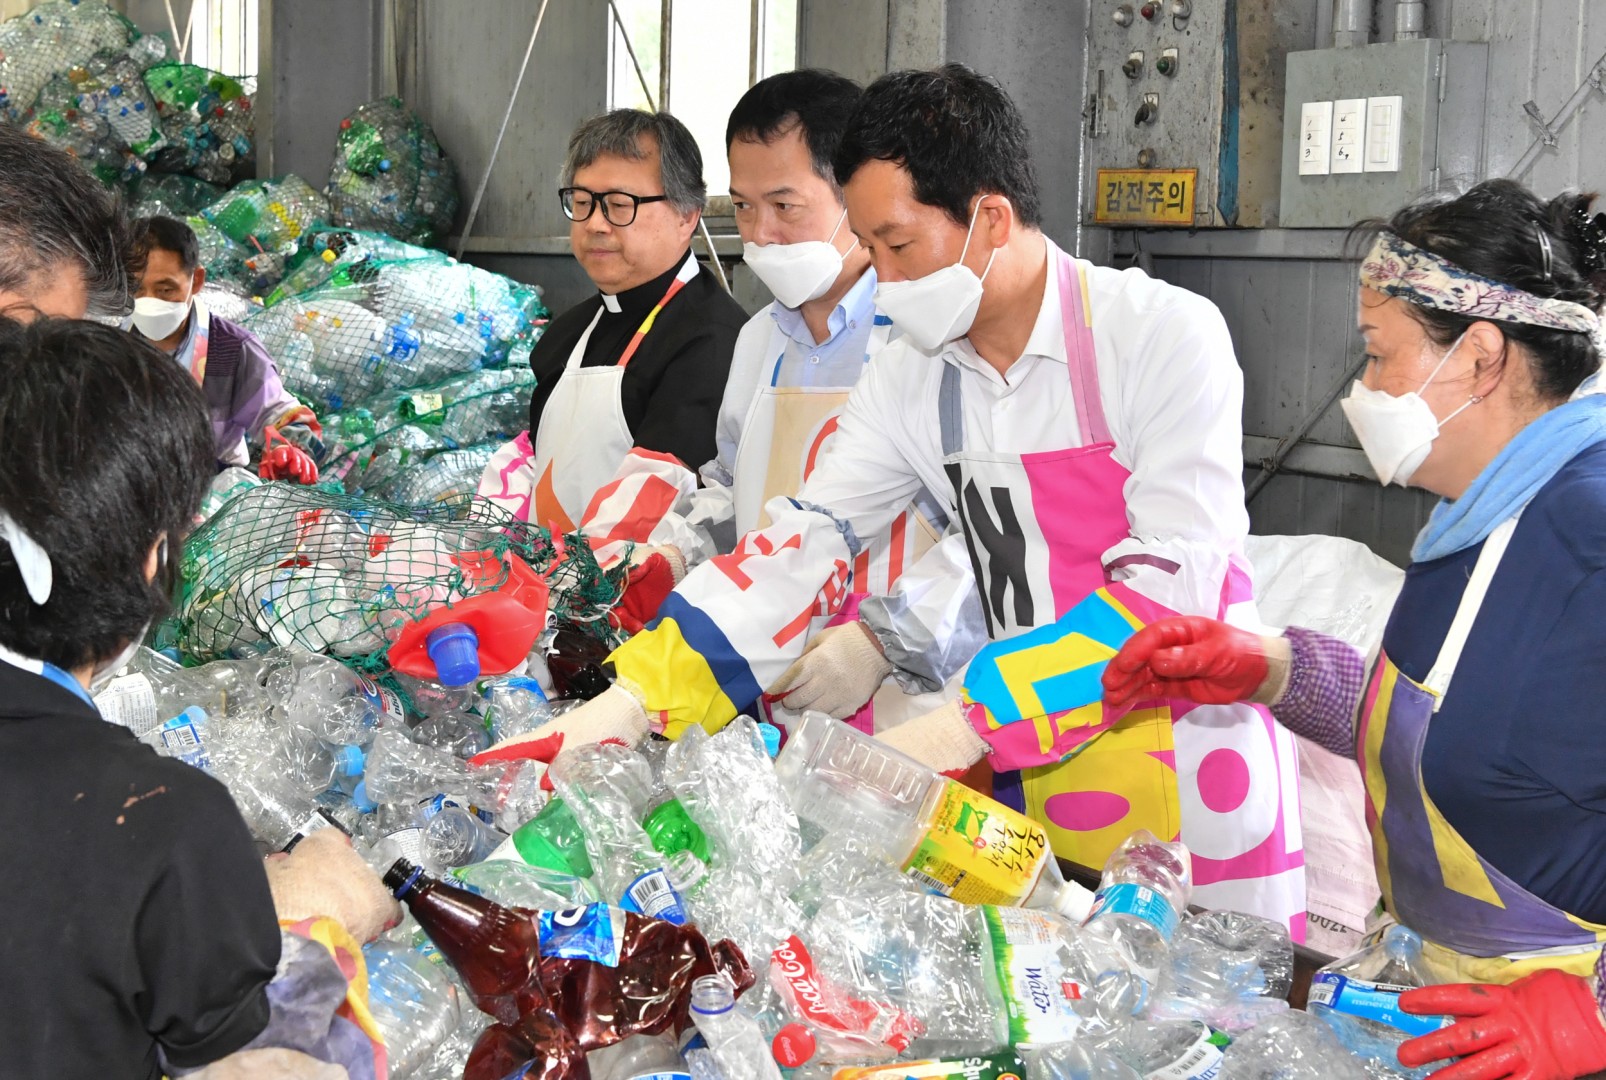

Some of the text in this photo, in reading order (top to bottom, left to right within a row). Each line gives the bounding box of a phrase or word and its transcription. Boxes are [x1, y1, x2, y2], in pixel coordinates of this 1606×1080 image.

[1305, 148, 1311, 158] 3
[1106, 181, 1186, 214] 감전주의
[1003, 826, 1045, 875] 옥수수
[1024, 967, 1051, 1014] Water
[1352, 998, 1395, 1010] mineral
